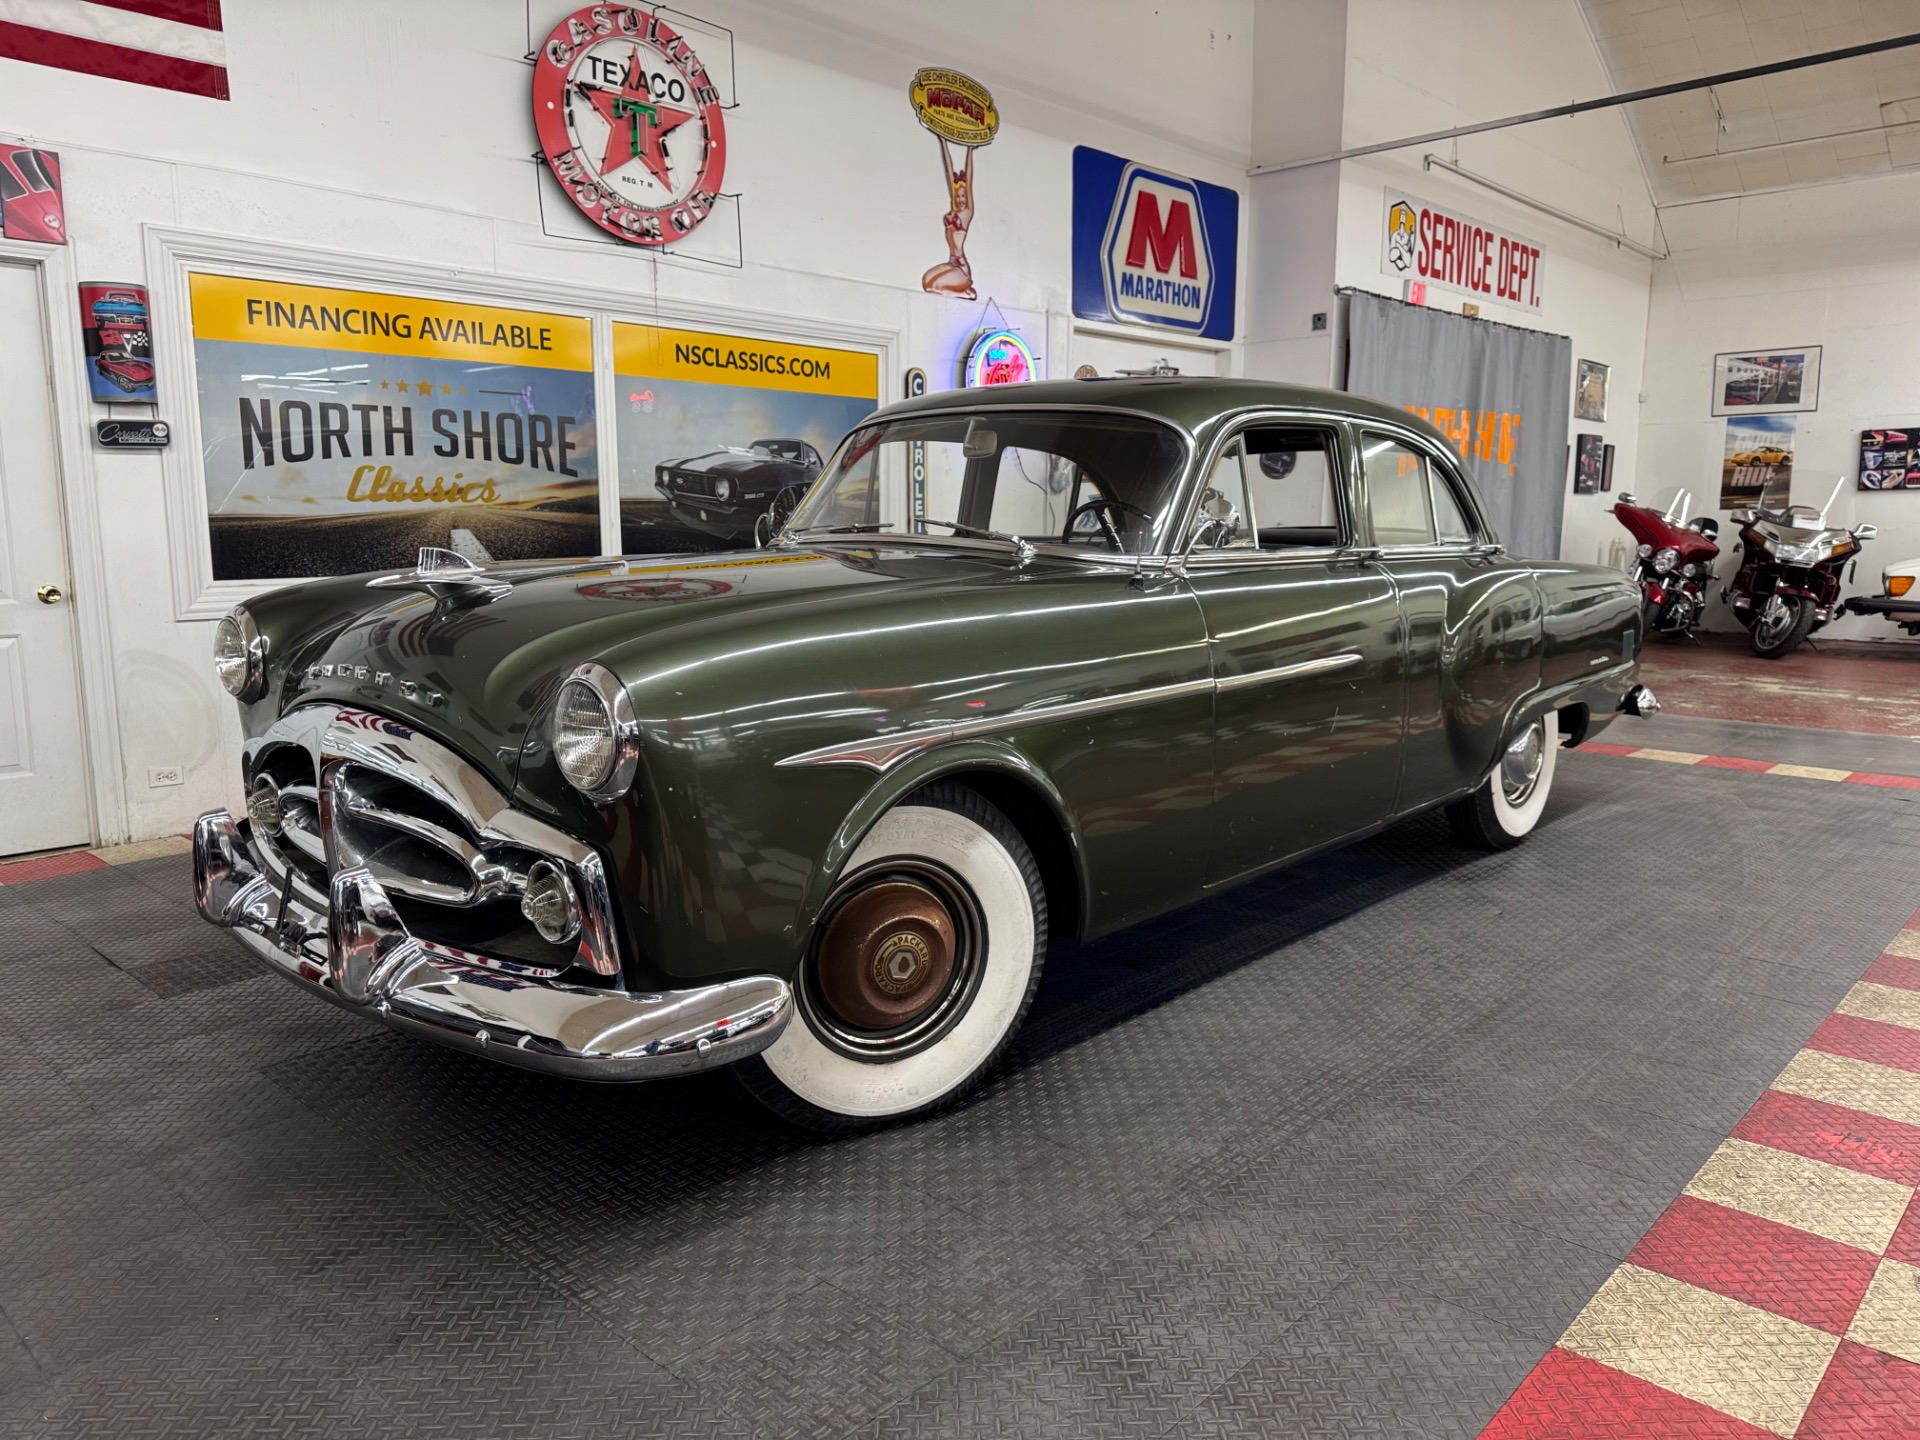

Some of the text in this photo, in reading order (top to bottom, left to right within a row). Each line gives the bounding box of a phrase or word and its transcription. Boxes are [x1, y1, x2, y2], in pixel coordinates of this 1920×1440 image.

[586, 55, 685, 102] TEXACO
[927, 87, 985, 126] MOPAR
[1125, 190, 1198, 280] M
[1417, 208, 1541, 308] SERVICE DEPT.
[1120, 271, 1201, 309] MARATHON
[247, 298, 553, 351] FINANCING AVAILABLE
[675, 343, 831, 379] NSCLASSICS.COM
[99, 423, 155, 442] Corvette
[239, 397, 579, 478] NORTH SHORE
[346, 464, 503, 504] Classics
[897, 936, 928, 966] PACKARD
